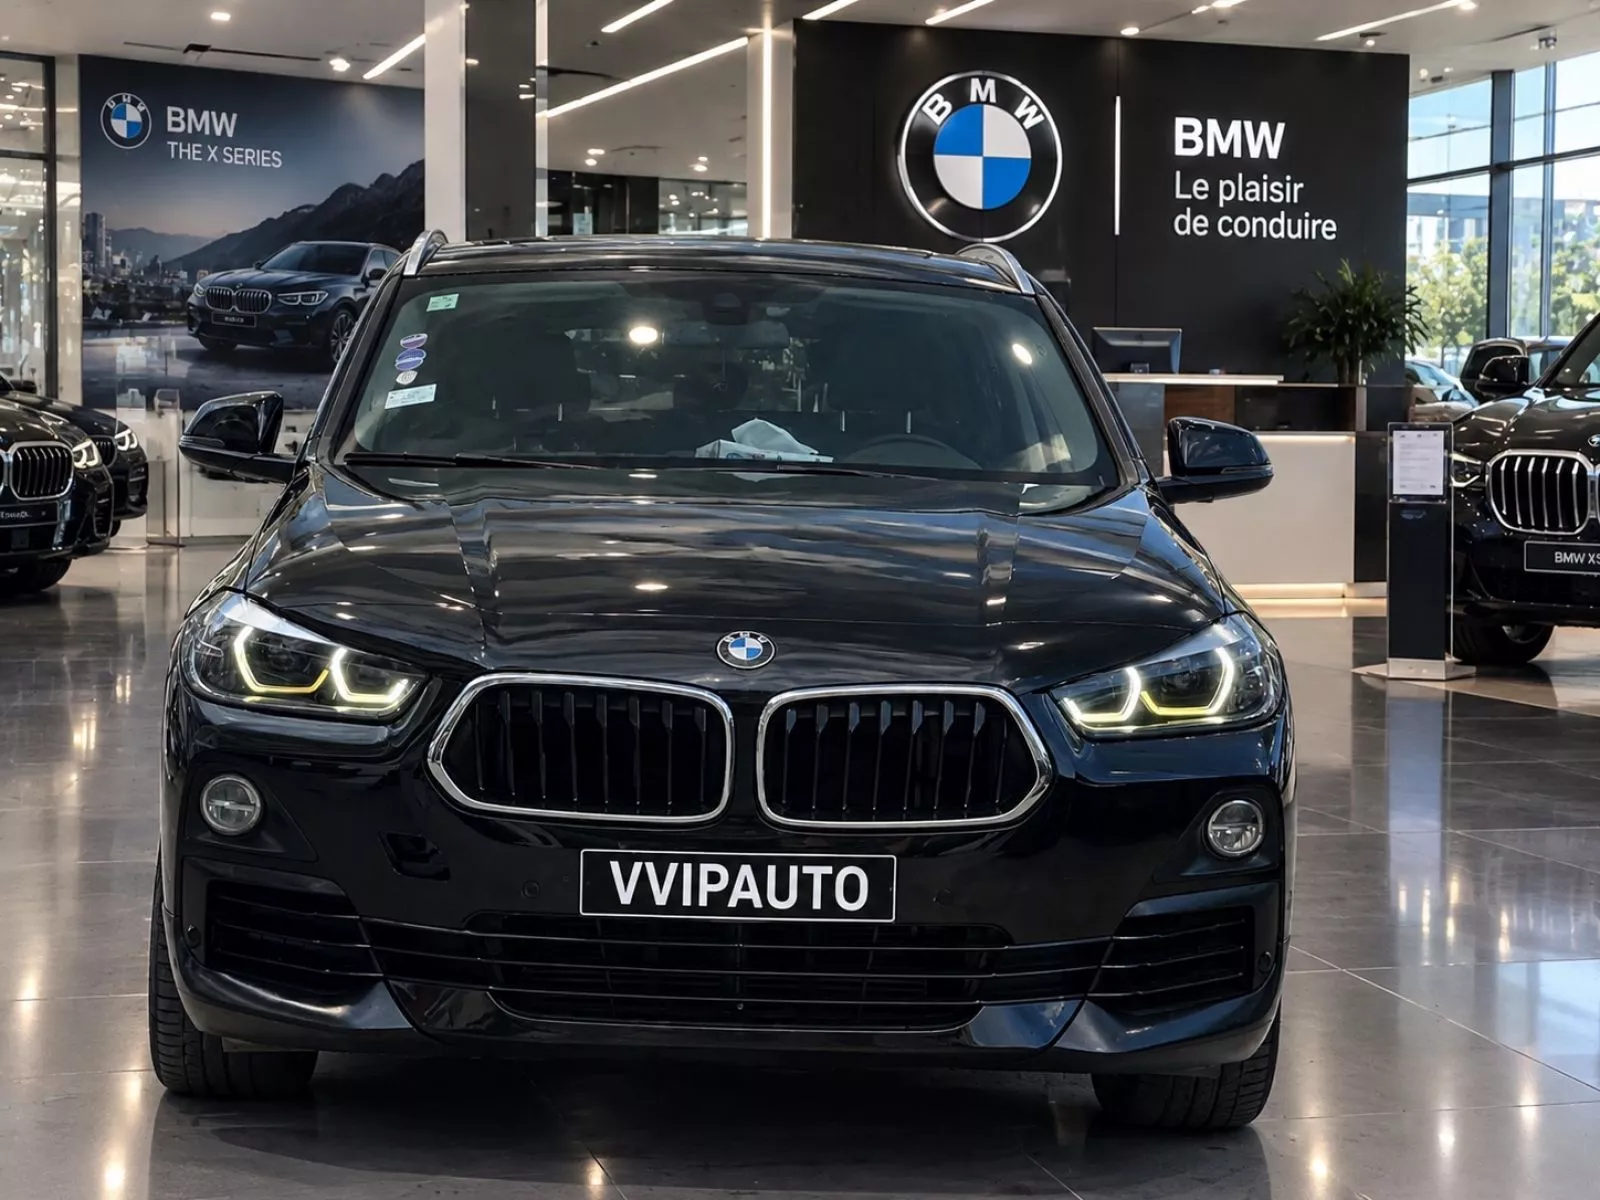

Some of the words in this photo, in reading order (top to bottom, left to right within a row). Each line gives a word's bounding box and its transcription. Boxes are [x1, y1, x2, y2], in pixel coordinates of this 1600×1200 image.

[921, 78, 1044, 127] BMW
[168, 106, 237, 137] BMW
[1175, 117, 1285, 159] BMW
[167, 142, 202, 161] THE
[207, 145, 218, 162] X
[223, 147, 282, 168] SERIES
[1176, 171, 1209, 200] Le
[1219, 173, 1304, 207] plaisir
[1174, 207, 1209, 236] de
[1218, 211, 1337, 240] conduire
[1555, 552, 1585, 563] BMW
[610, 861, 868, 911] VVIPAUTO
